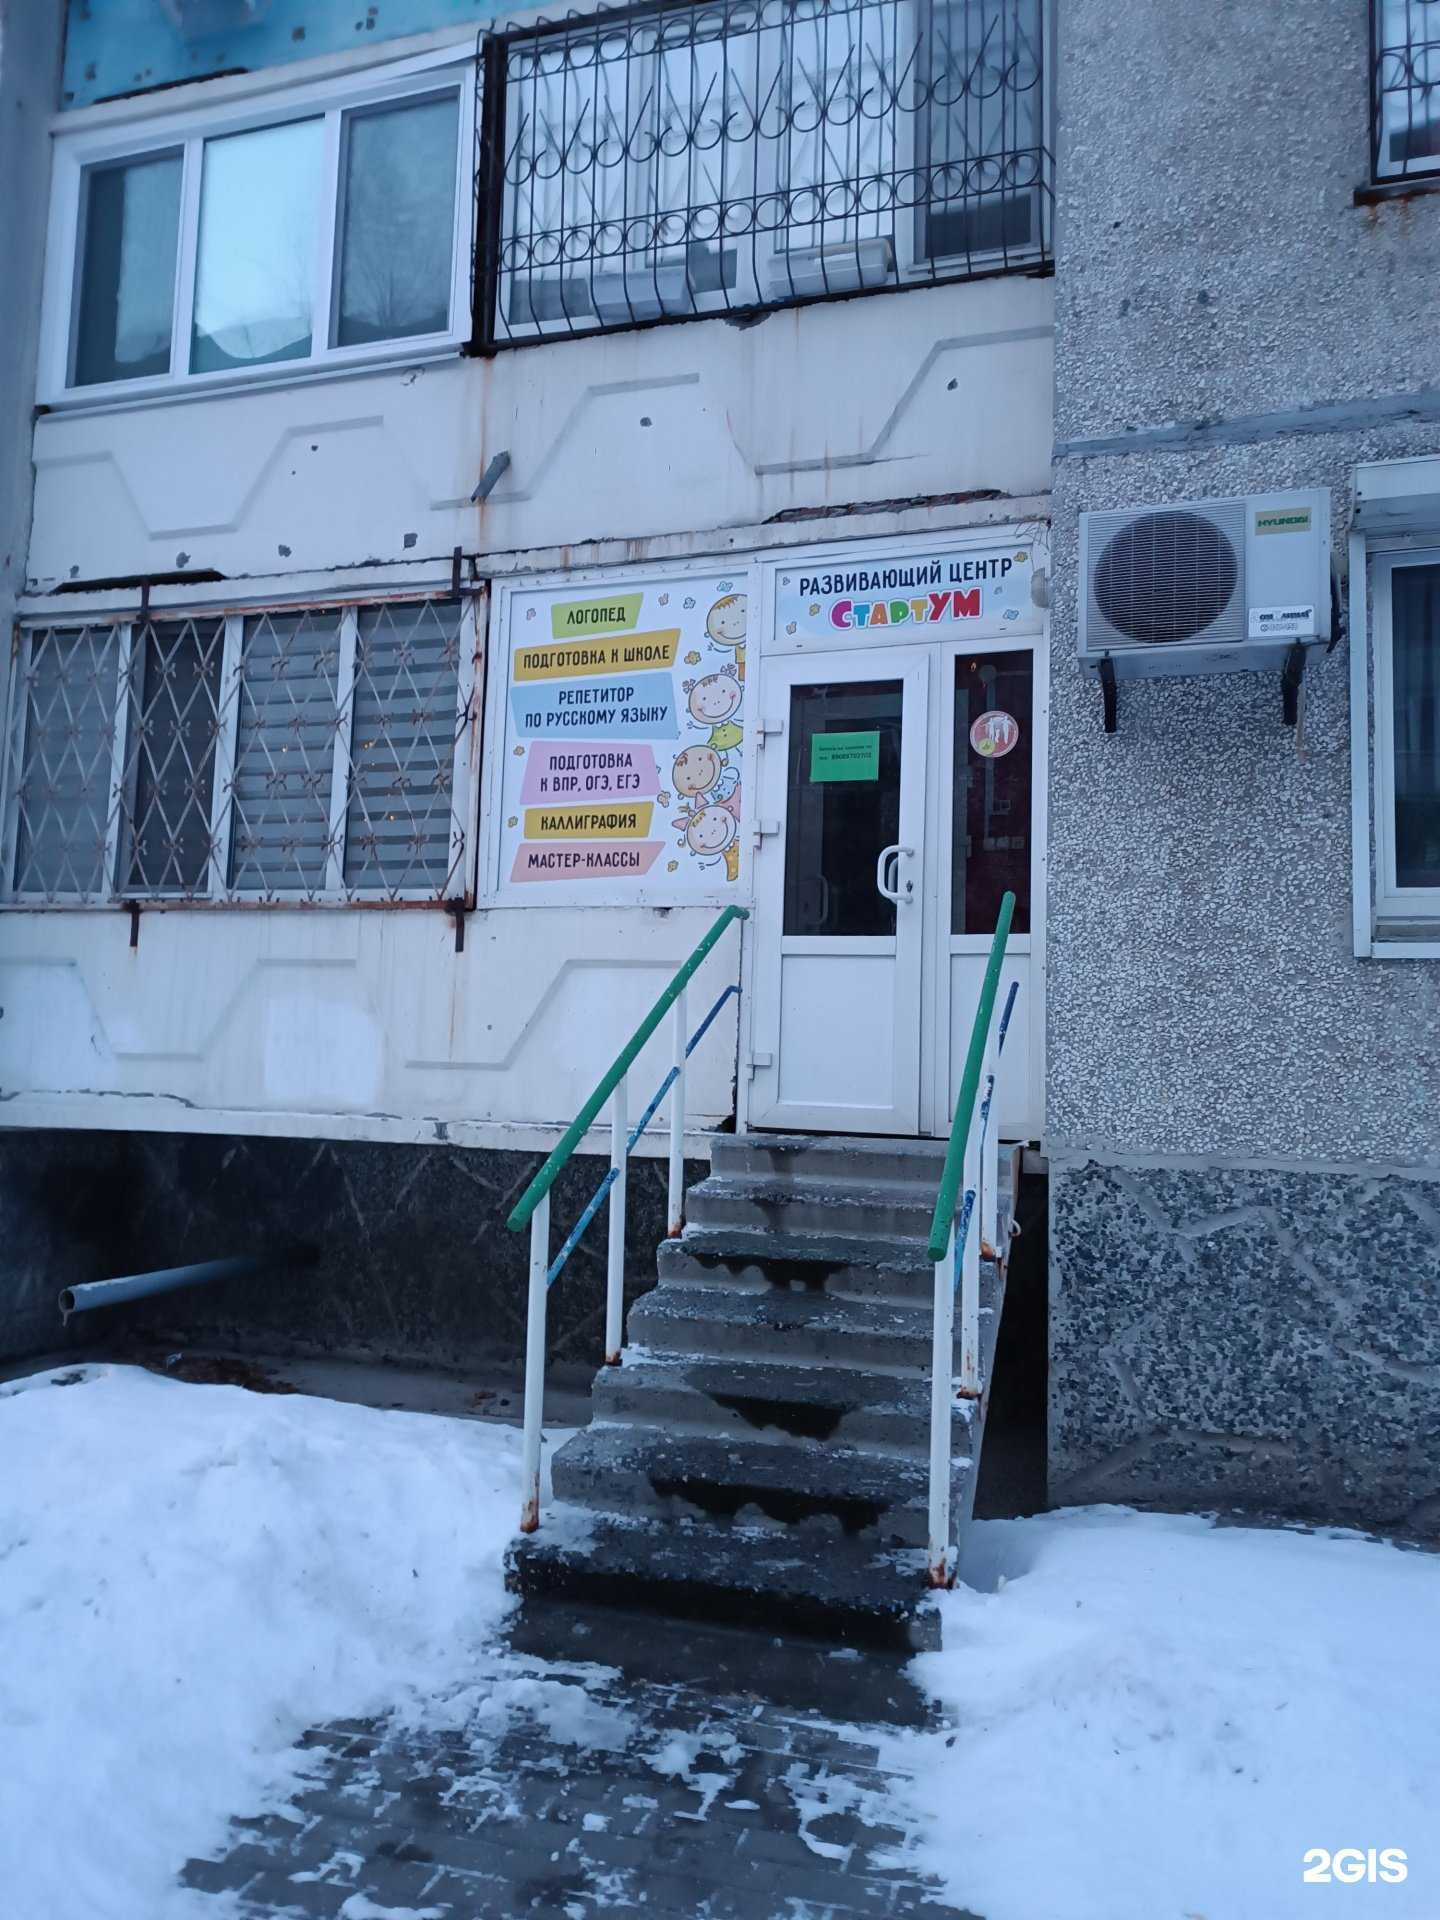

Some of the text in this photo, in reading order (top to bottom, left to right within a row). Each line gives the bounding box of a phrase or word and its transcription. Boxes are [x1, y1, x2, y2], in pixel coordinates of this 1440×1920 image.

[1258, 515, 1309, 528] HYUNDAI
[800, 558, 1013, 596] РАЗВИВАЮЩИЙ ЦЕНТР
[566, 607, 626, 625] ЛОГОПЕД
[523, 645, 670, 669] ПОДГОТОВКА К ШКОЛЕ
[558, 687, 634, 705] РЕПЕТИТОР
[525, 706, 668, 728] ПО РУССКОМУ ЯЗЫКУ
[549, 753, 633, 772] ПОДГОТОВКА
[540, 774, 640, 794] К ВПР, ОГЭ, ЕГЭ
[540, 813, 637, 831] КАЛЛИГРАФИЯ
[527, 852, 640, 868] МАСТЕР-КЛАССЫ
